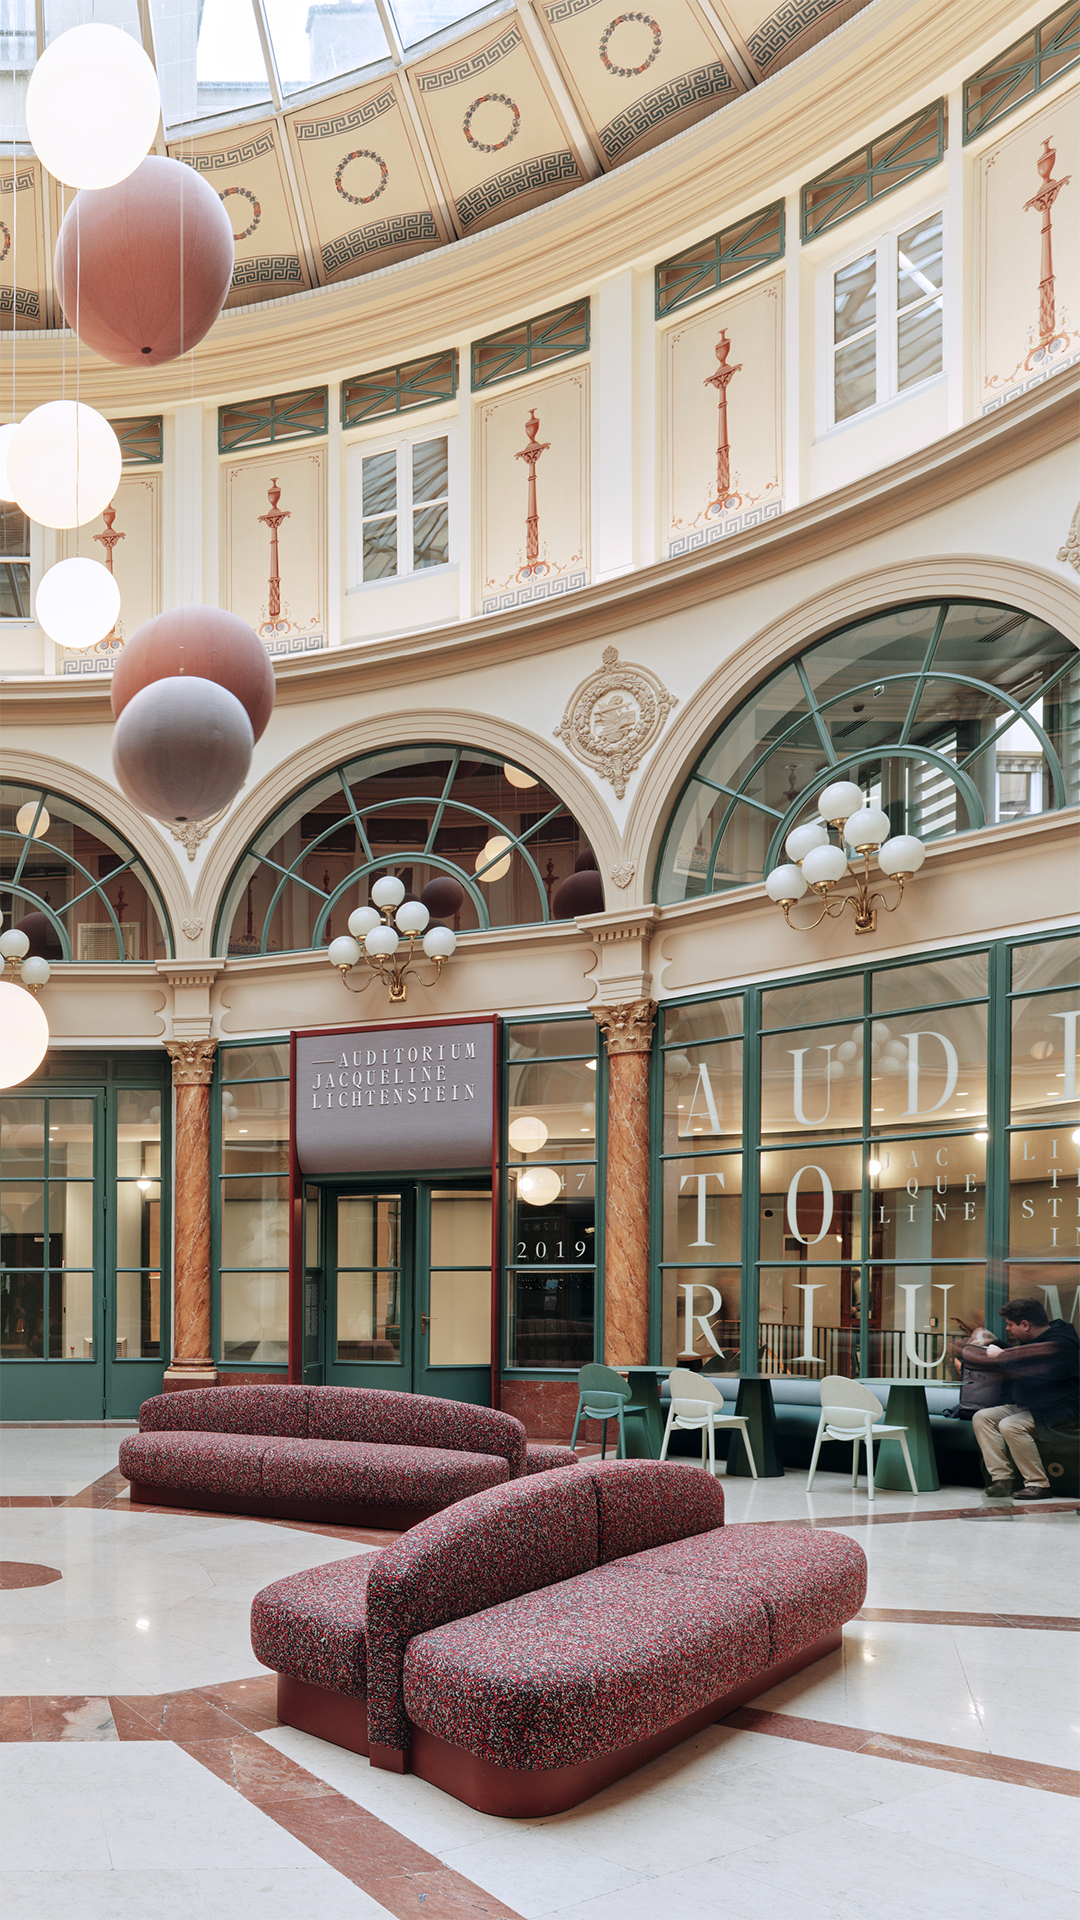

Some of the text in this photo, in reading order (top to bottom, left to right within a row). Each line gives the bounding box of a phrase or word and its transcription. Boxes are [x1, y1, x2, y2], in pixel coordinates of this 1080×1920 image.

[338, 1042, 476, 1068] AUDITORIUM
[312, 1065, 446, 1090] JACQUELINE
[312, 1084, 476, 1110] LICHTENSTEIN
[880, 1147, 948, 1170] JAC
[906, 1173, 977, 1200] QUE
[879, 1202, 976, 1224] LINE
[516, 1240, 587, 1259] 2019
